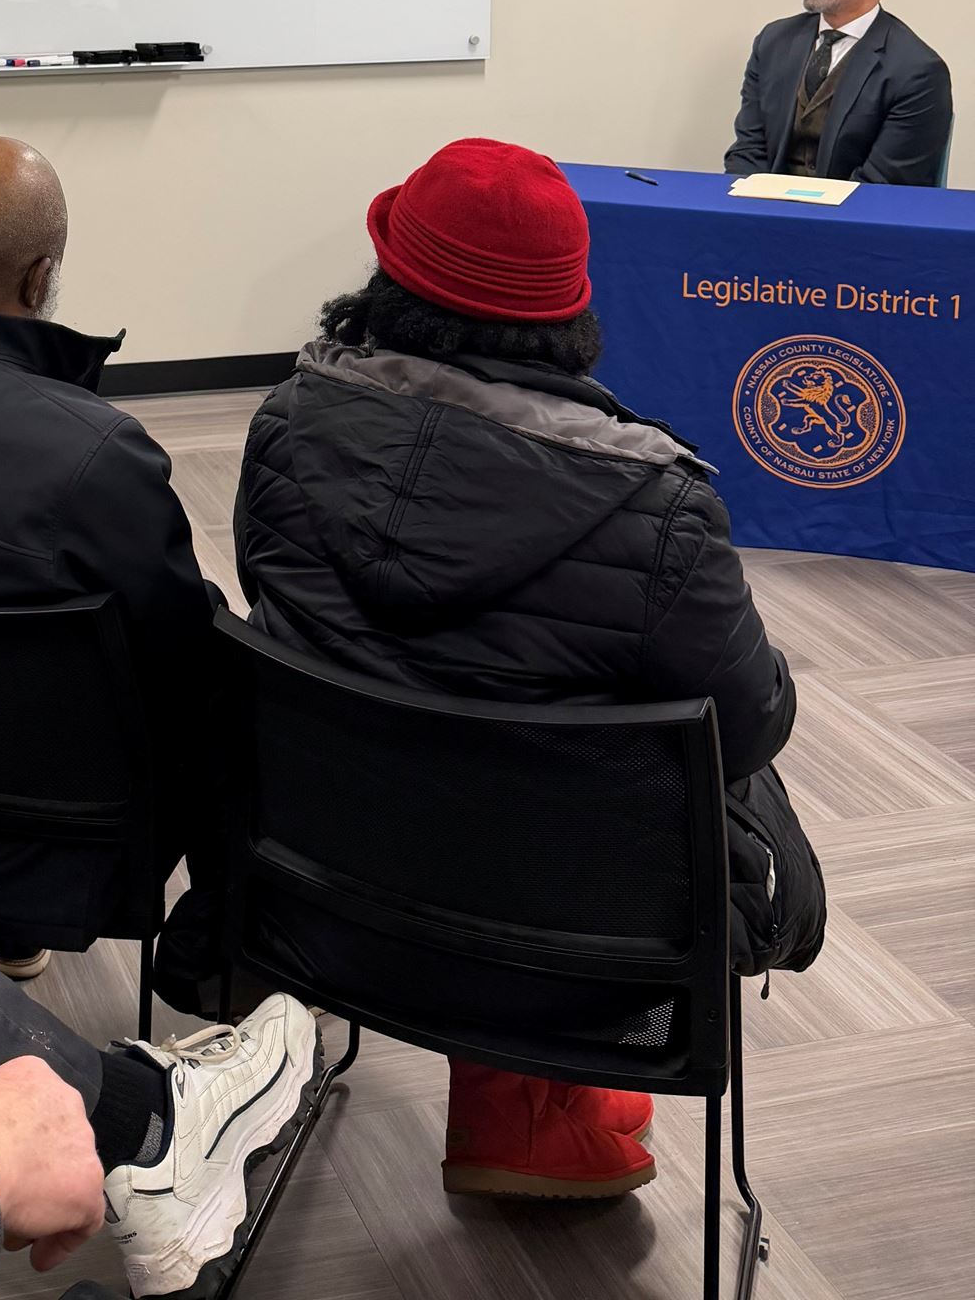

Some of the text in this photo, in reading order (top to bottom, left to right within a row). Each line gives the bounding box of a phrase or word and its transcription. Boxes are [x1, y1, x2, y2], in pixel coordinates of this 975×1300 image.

[682, 272, 961, 319] Legislative District 1
[747, 344, 890, 398] NASSAU COUNTY LEGISLATURE
[743, 406, 896, 479] COUNTY OF NASSAU STATE OF NEW YORK
